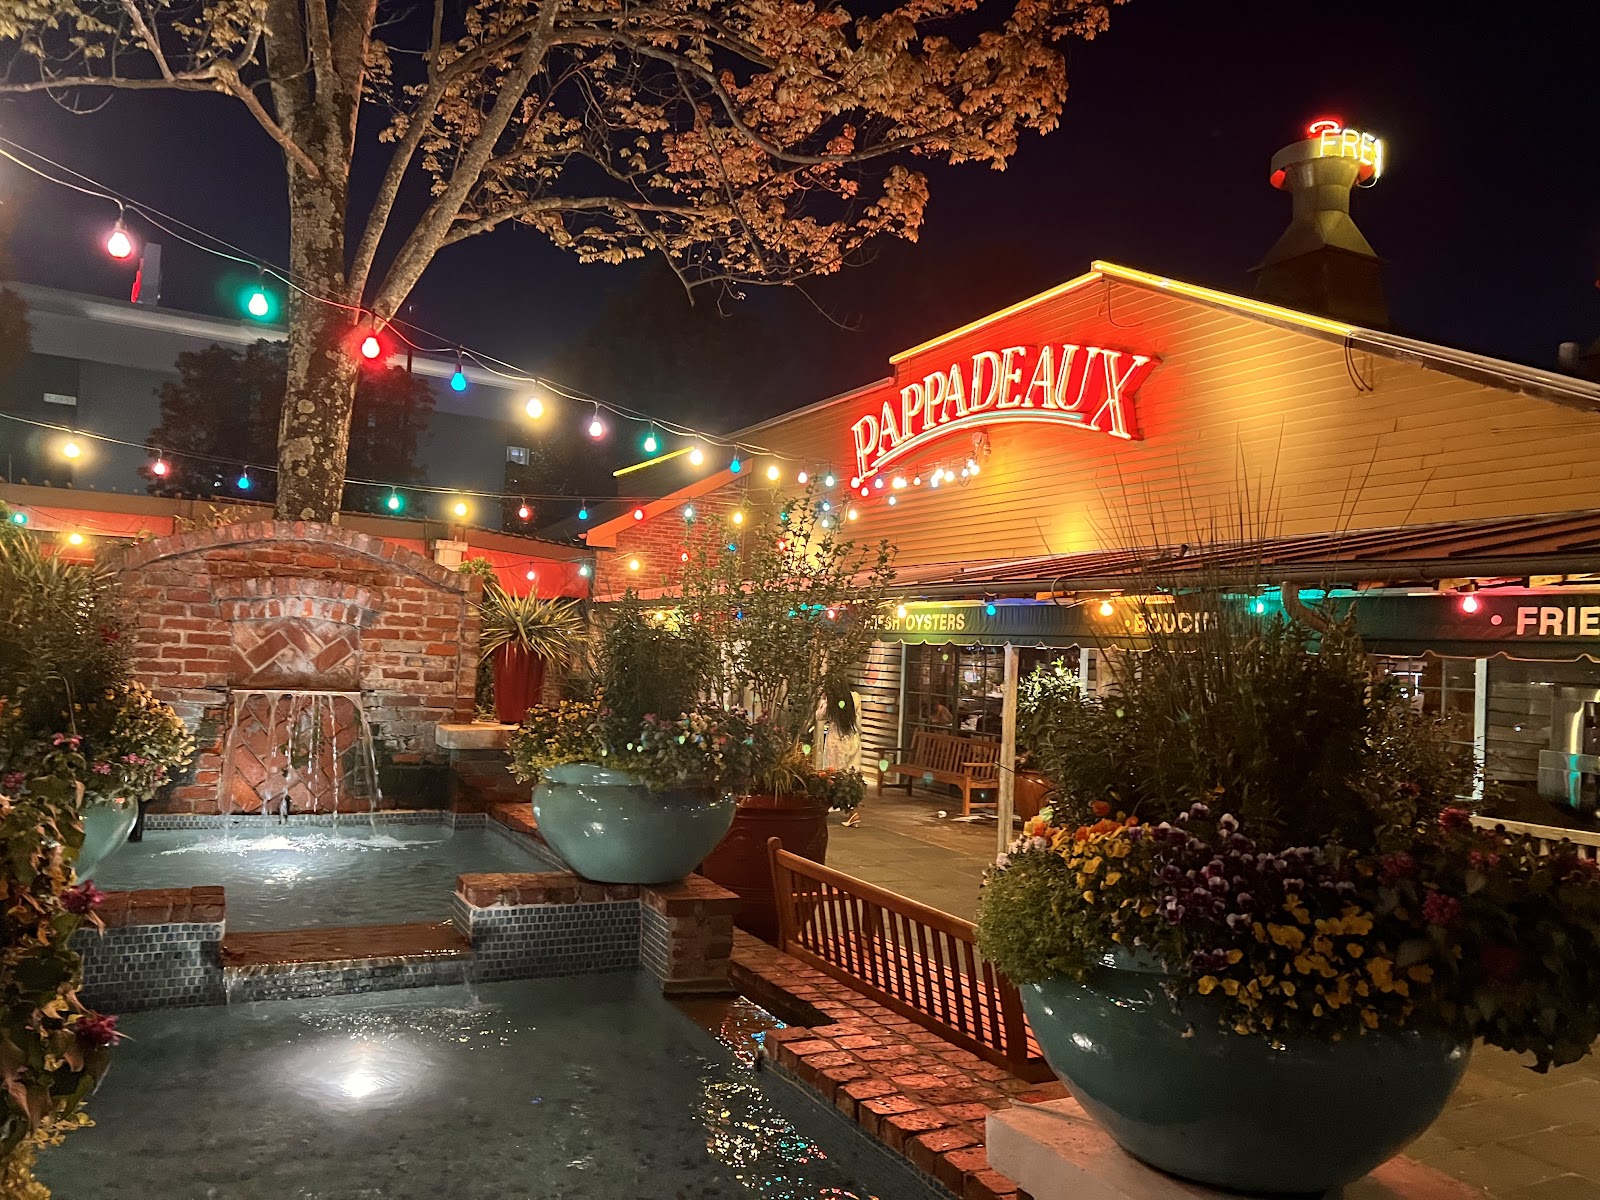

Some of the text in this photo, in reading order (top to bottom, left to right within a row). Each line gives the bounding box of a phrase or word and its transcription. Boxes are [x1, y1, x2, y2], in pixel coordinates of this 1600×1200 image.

[1319, 128, 1383, 179] FRE
[850, 343, 1153, 483] PAPPADEAUX
[905, 613, 966, 631] OYSTERS
[1516, 606, 1600, 636] FRIE
